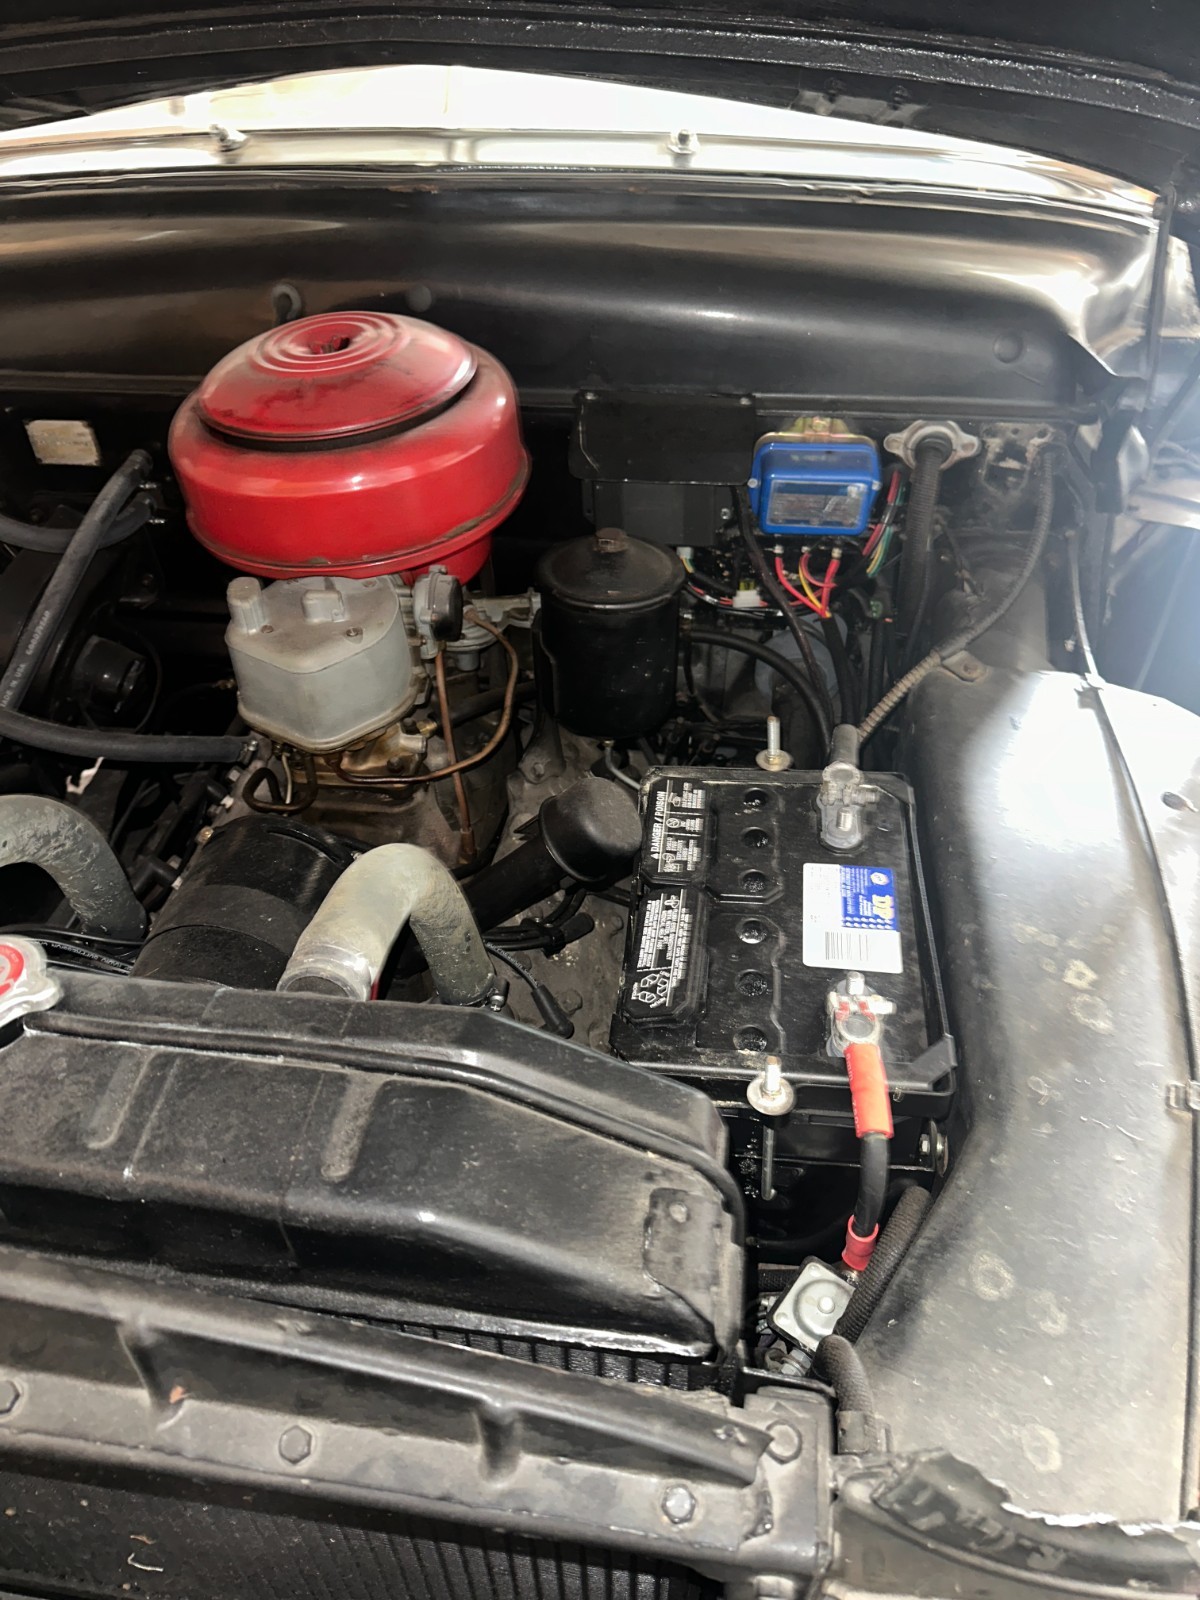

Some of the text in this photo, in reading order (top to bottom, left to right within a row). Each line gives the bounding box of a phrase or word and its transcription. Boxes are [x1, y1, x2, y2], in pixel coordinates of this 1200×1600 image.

[14, 663, 27, 678] USA
[25, 609, 51, 656] GOODYEAR
[654, 791, 666, 816] POISON
[650, 822, 663, 852] DANGER
